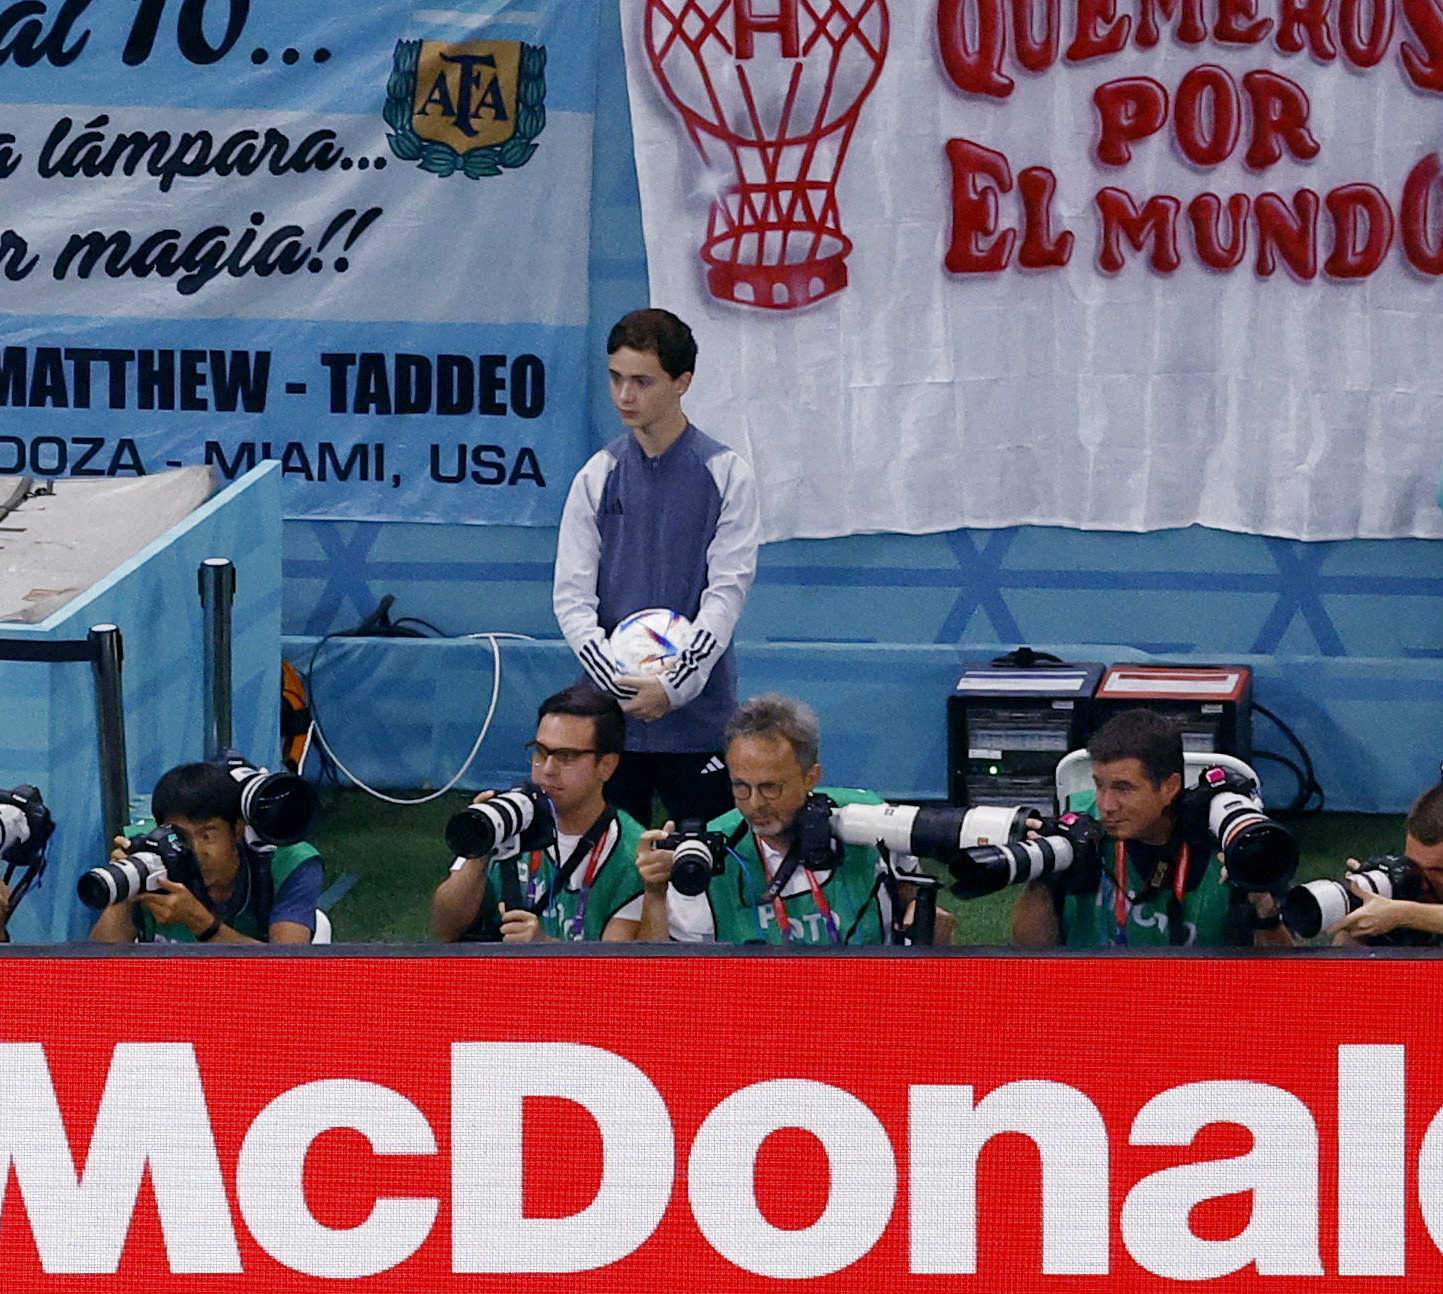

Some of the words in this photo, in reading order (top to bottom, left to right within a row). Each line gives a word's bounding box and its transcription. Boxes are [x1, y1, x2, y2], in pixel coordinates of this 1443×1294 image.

[36, 114, 388, 193] lámpara...
[1093, 63, 1321, 170] POR
[944, 137, 1075, 274] EL
[51, 207, 383, 296] magia!!
[320, 353, 546, 418] TADDEO
[429, 441, 547, 488] USA
